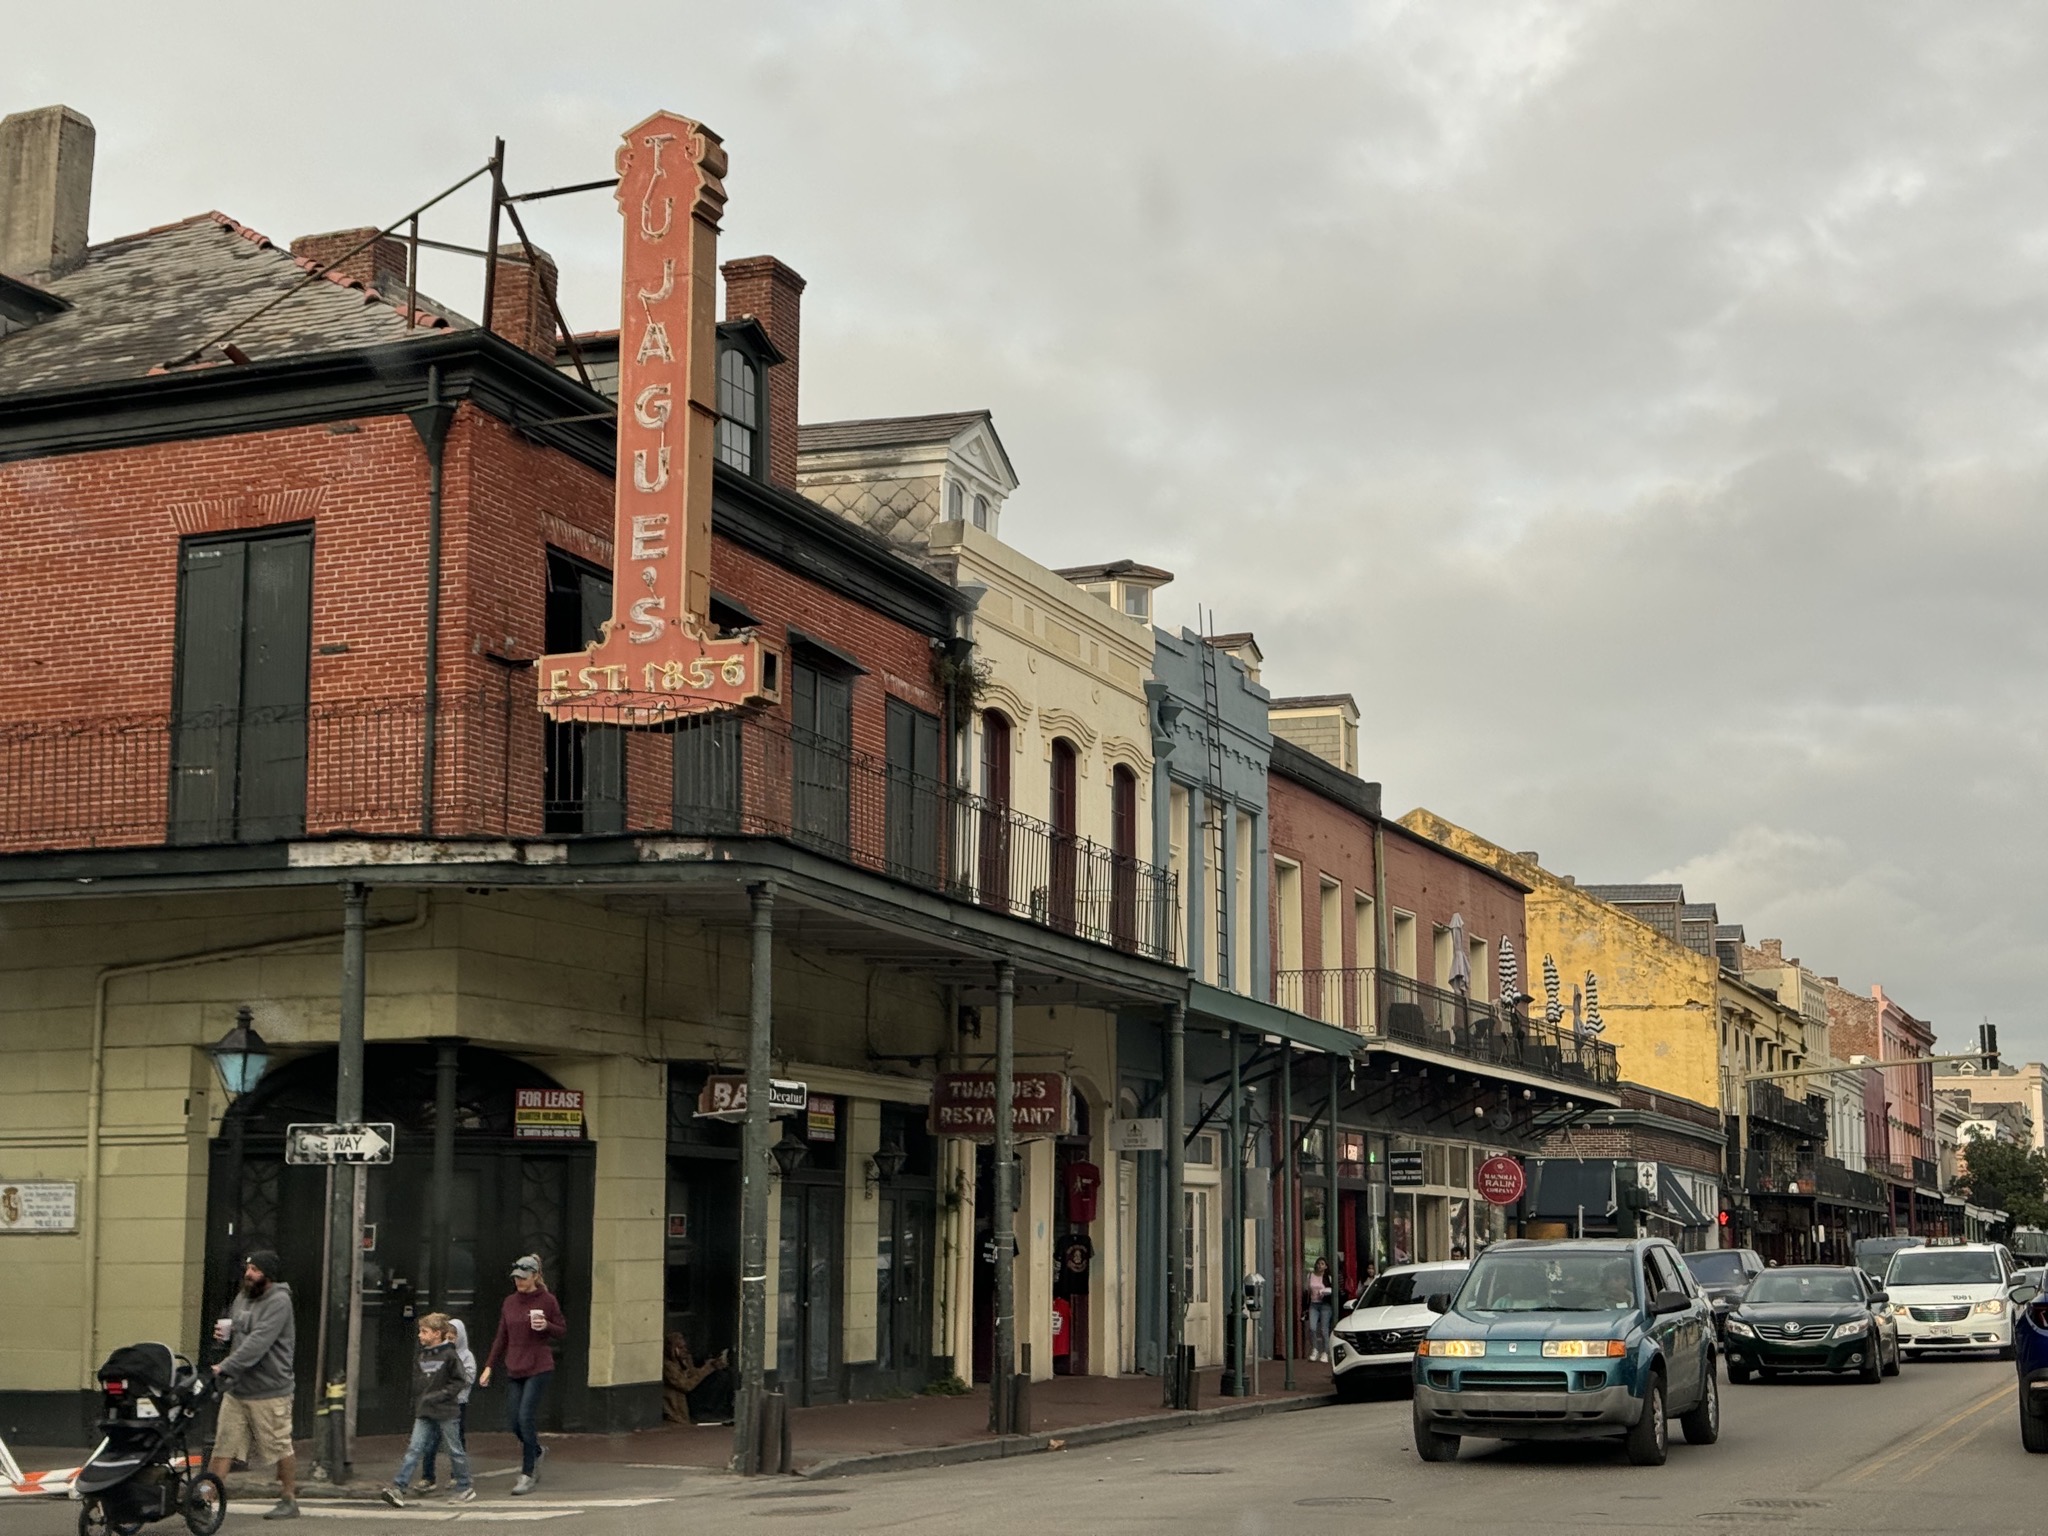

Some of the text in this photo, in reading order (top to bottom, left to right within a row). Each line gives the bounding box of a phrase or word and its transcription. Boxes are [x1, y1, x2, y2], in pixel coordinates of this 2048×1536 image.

[629, 133, 677, 646] TUJAGUE'S
[643, 654, 745, 692] 1856
[769, 1087, 803, 1104] Decatur
[949, 1079, 1046, 1099] TUJAUE'S
[519, 1091, 580, 1108] FOR LEASE
[940, 1106, 1055, 1125] RESTARANT
[334, 1137, 362, 1151] WAY
